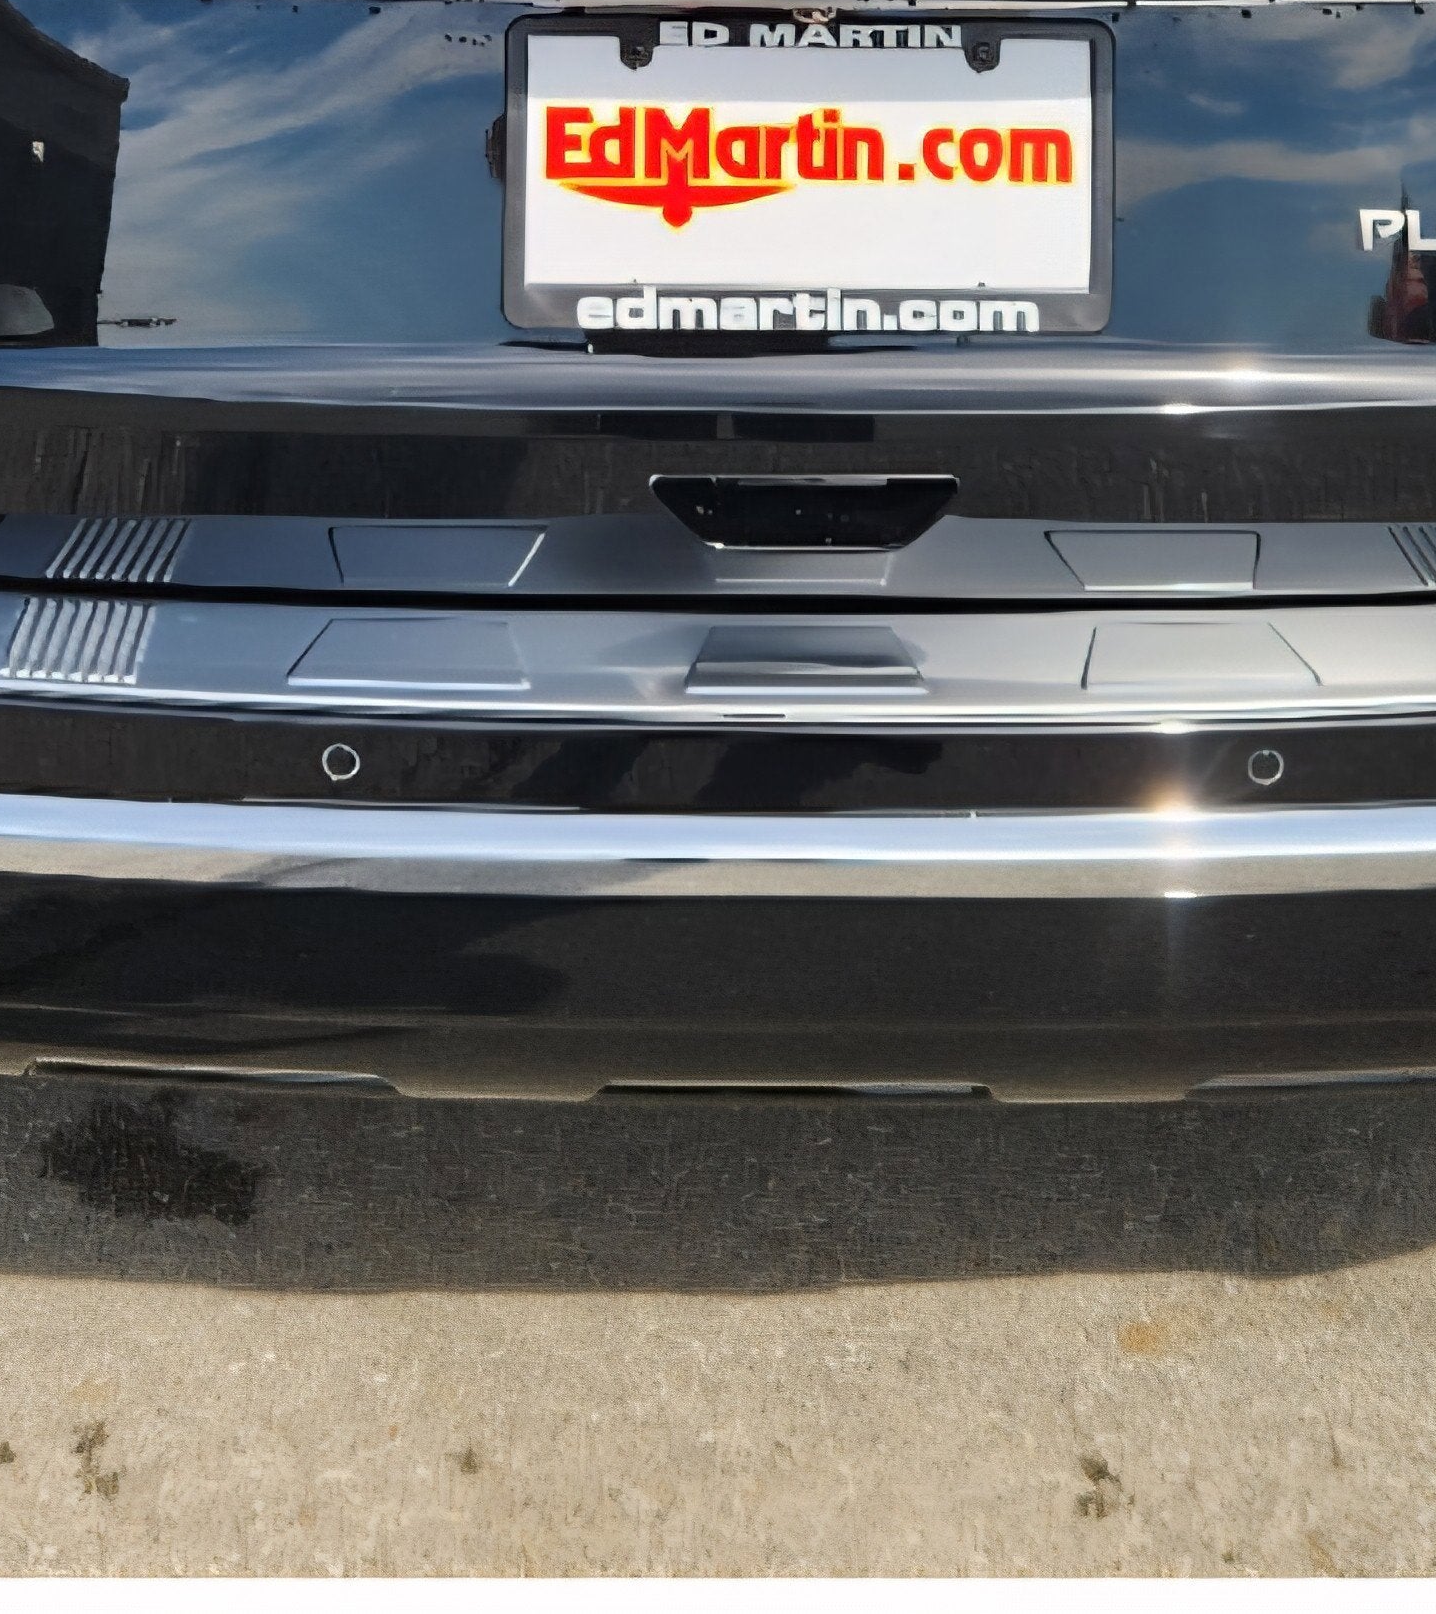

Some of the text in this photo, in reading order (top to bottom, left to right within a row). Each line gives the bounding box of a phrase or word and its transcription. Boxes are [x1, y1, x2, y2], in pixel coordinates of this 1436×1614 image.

[659, 21, 963, 48] ED MARTIN
[545, 106, 1073, 182] EdMartin.com
[576, 286, 1040, 333] edmartin.com
